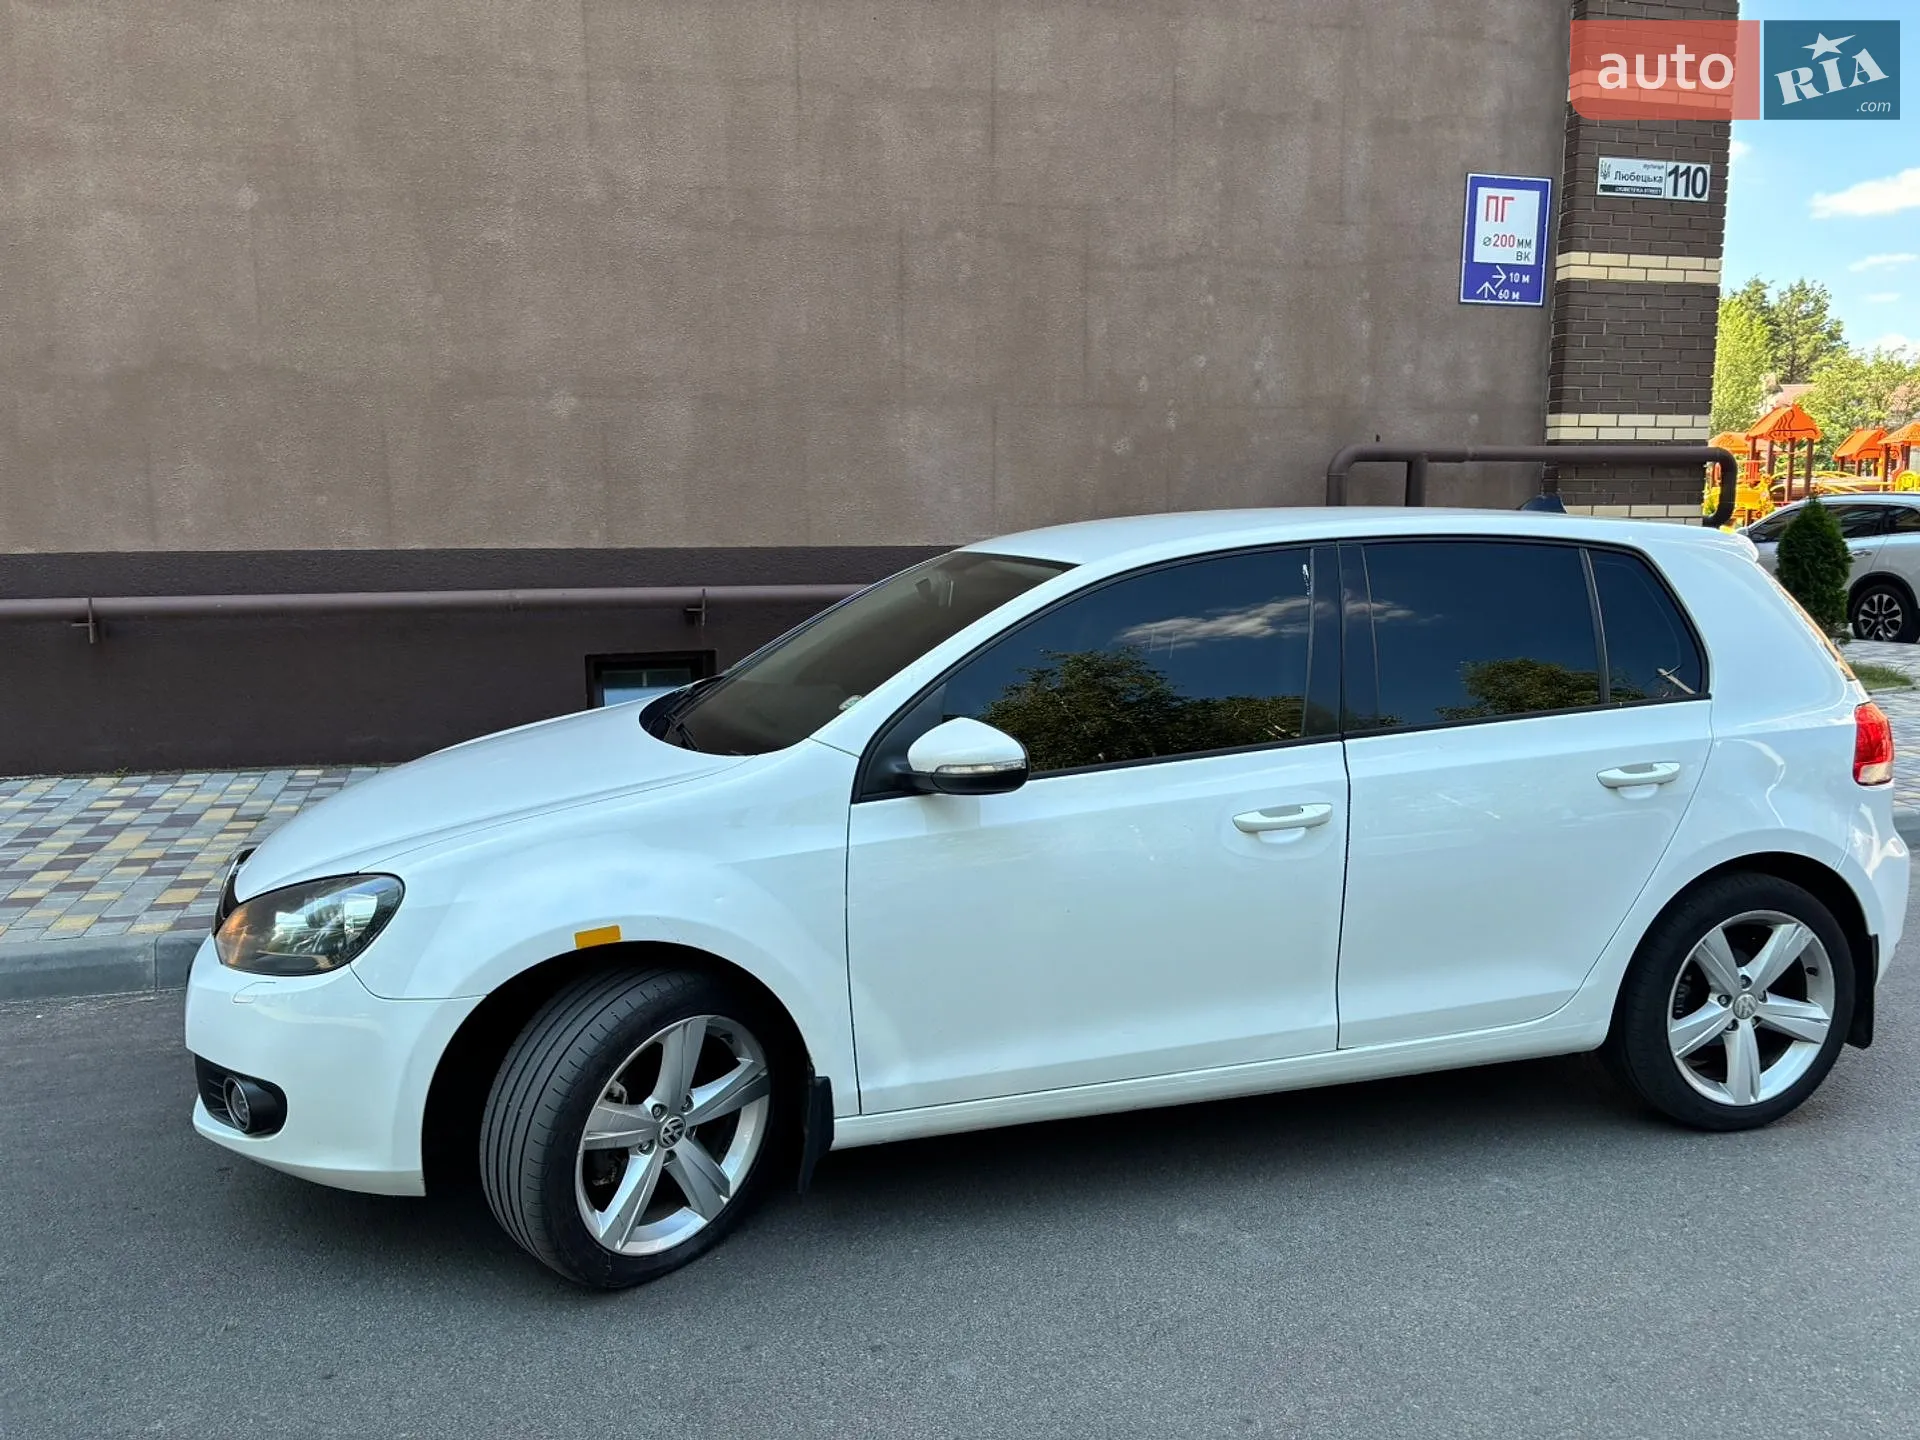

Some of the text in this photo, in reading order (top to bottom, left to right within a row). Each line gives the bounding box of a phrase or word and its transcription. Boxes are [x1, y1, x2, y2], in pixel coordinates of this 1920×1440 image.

[1614, 170, 1664, 183] Любецька
[1667, 164, 1708, 198] 110
[1485, 194, 1515, 223] ПГ
[1509, 272, 1520, 283] 10
